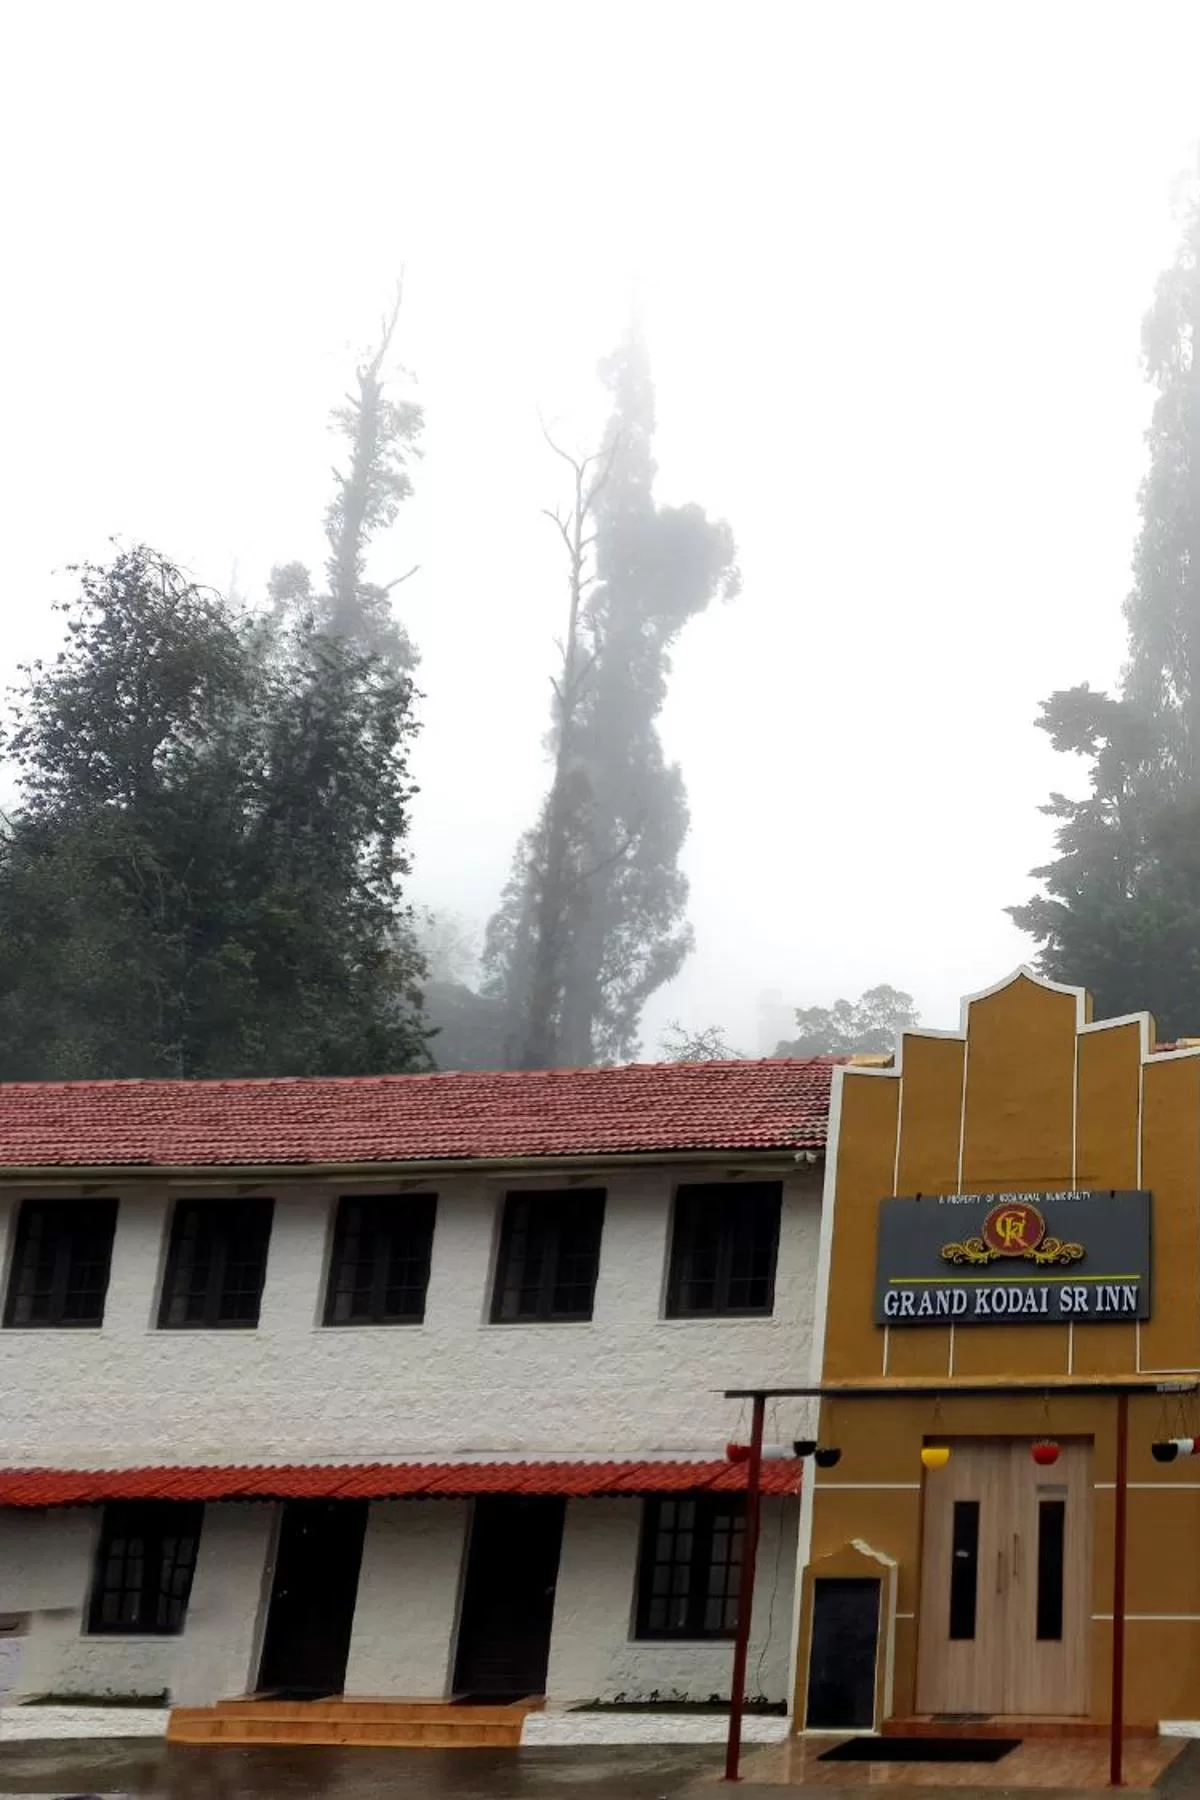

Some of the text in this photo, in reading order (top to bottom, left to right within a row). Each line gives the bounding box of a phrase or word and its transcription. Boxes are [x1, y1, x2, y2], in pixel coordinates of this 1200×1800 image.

[883, 1284, 1137, 1317] GRAND KODAI SR INN
